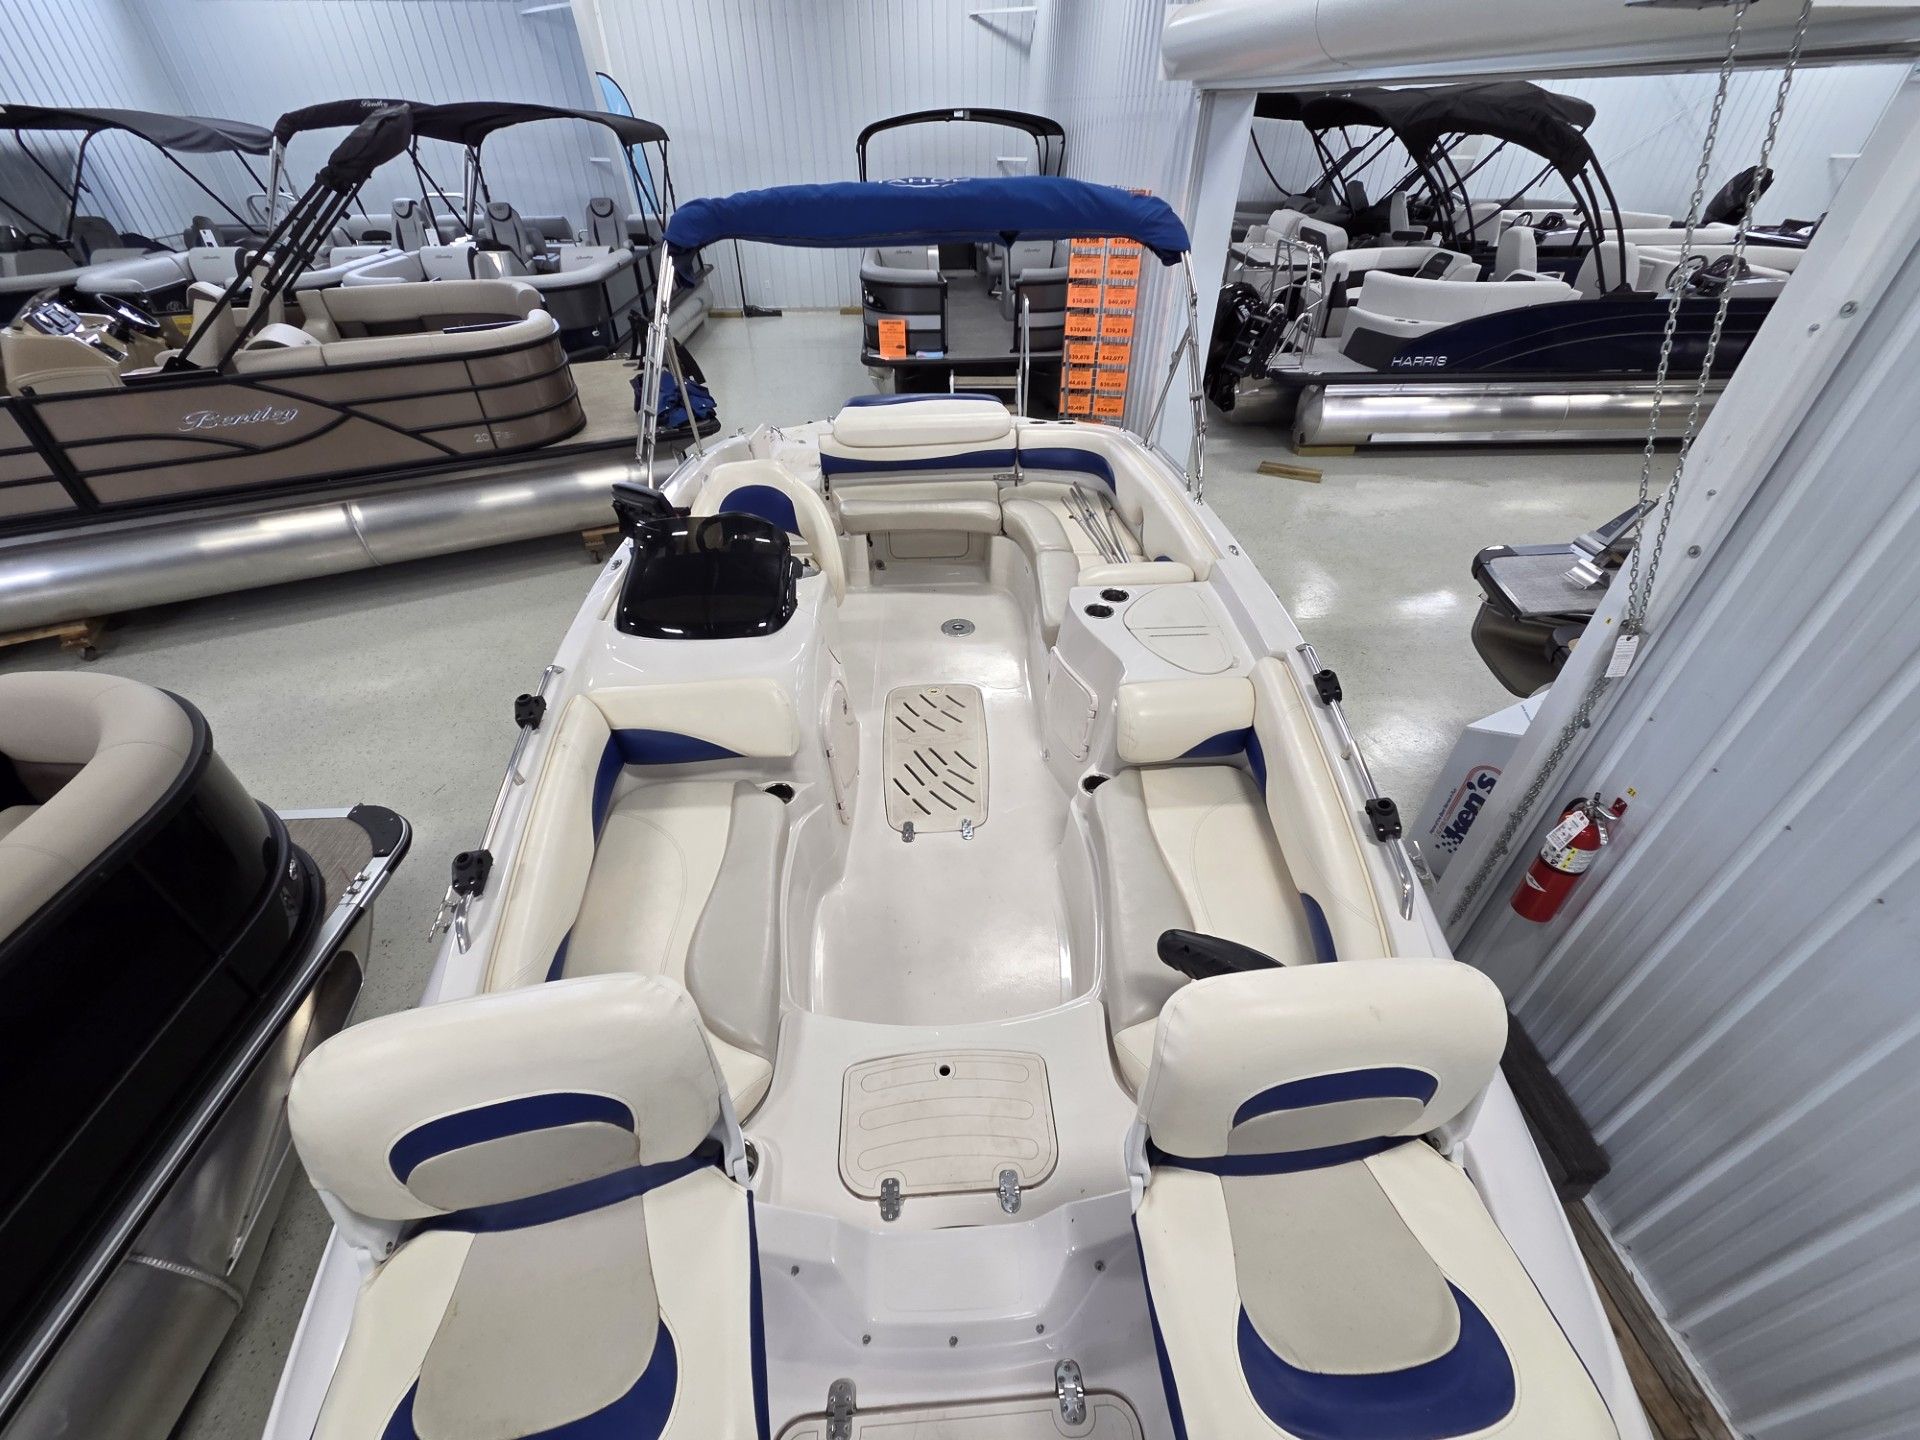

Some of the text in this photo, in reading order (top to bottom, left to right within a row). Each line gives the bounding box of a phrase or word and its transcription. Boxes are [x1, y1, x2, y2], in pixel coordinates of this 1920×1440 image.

[1390, 355, 1448, 367] HARRIS
[178, 403, 300, 432] Bentley
[1443, 772, 1497, 845] ken's
